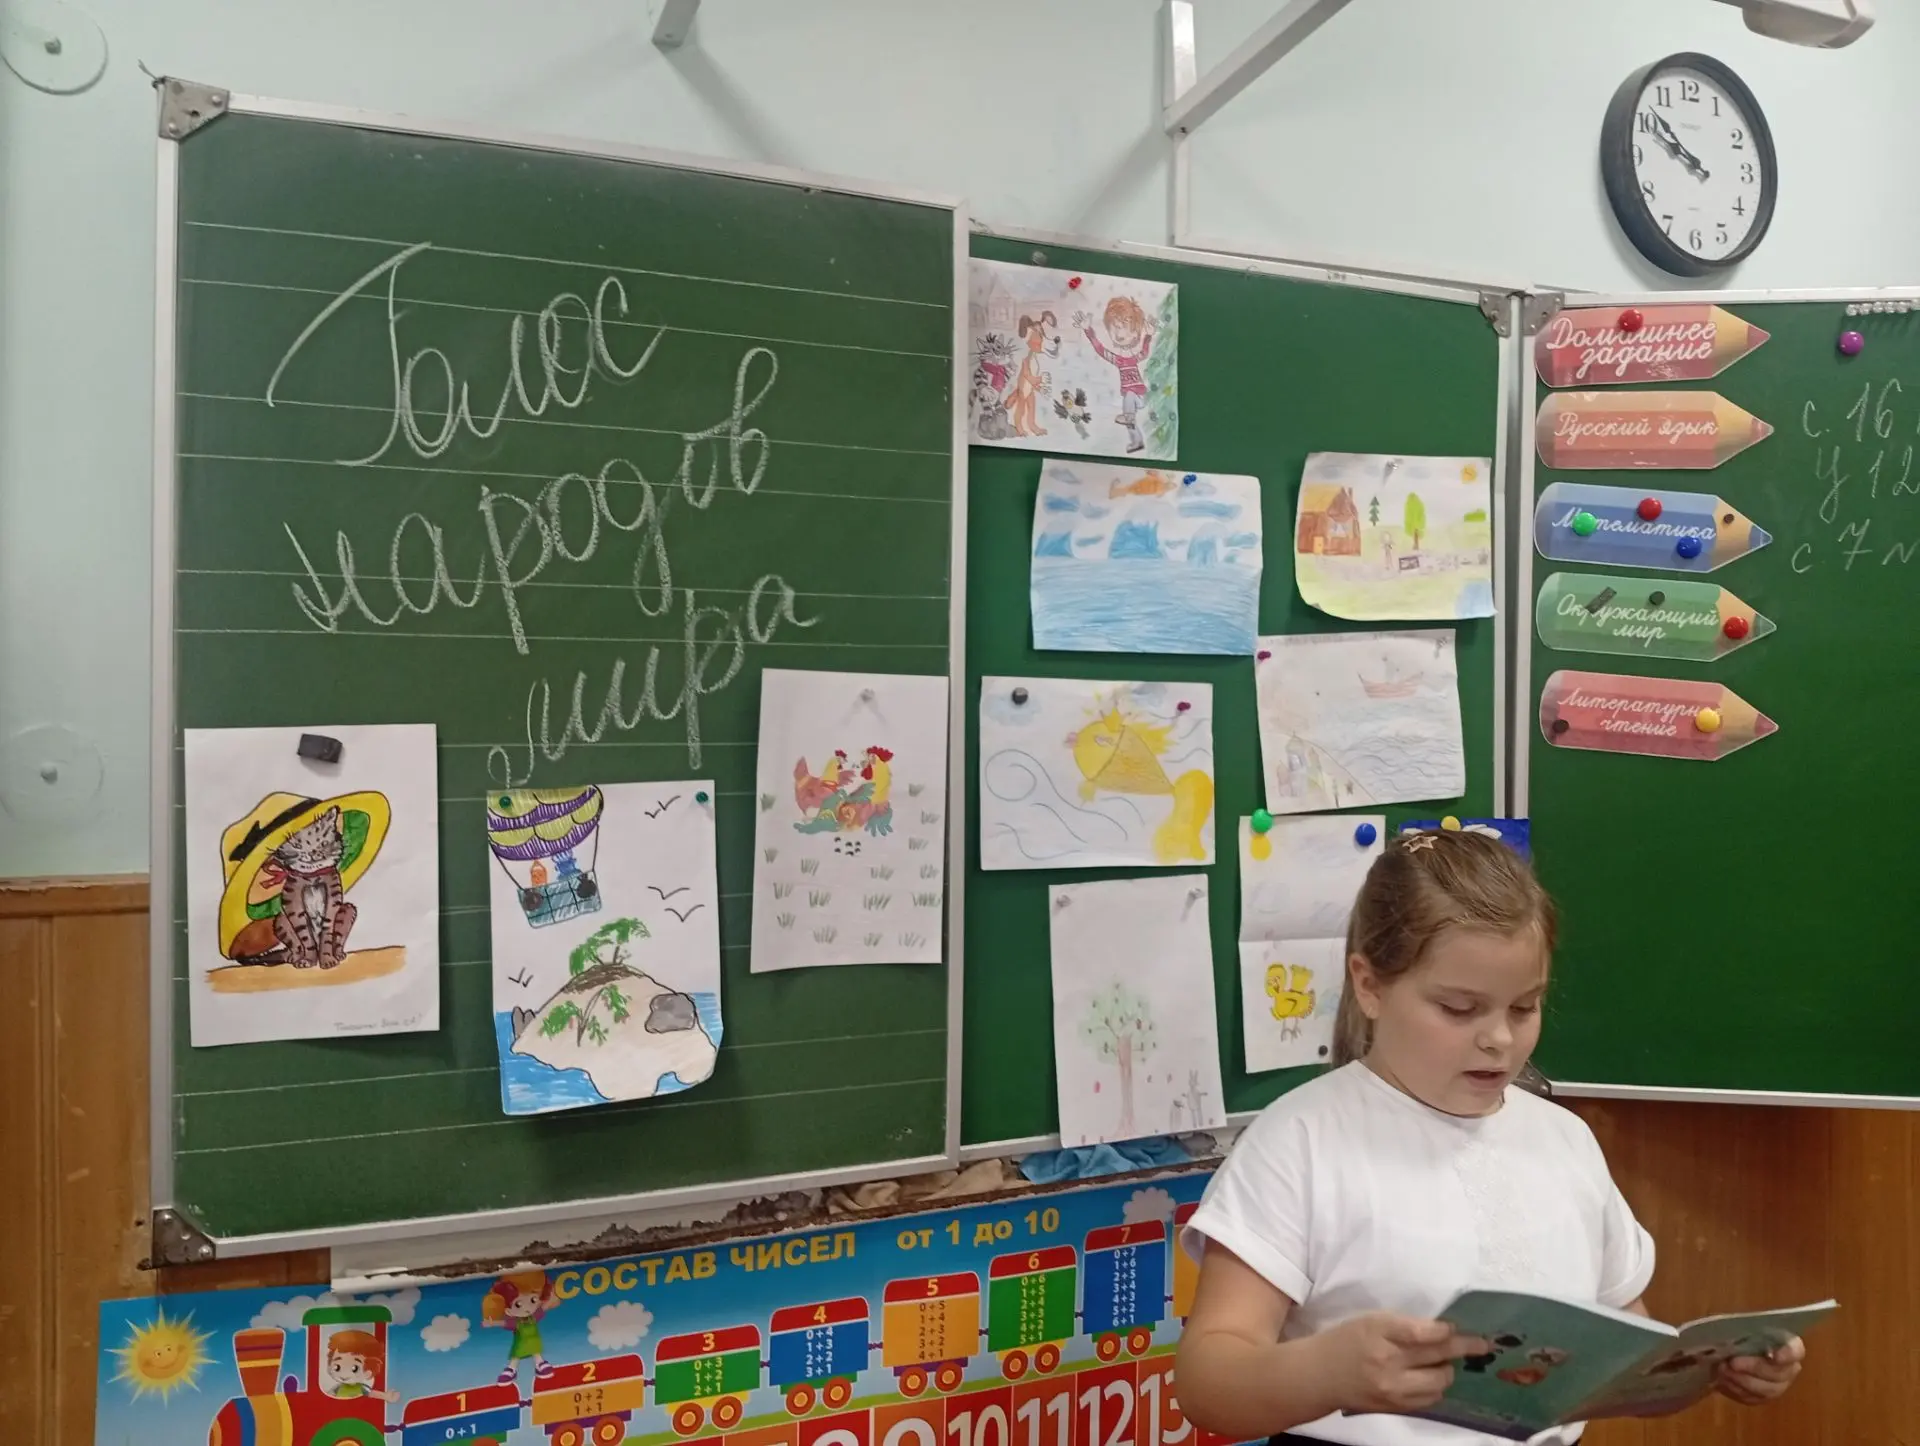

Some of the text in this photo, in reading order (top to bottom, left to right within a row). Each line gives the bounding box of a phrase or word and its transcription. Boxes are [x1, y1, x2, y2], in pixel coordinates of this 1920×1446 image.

[1656, 86, 1673, 108] 11
[1680, 80, 1699, 102] 12
[1712, 97, 1721, 117] 1
[1637, 112, 1658, 134] 10
[1731, 128, 1743, 150] 2
[1740, 162, 1754, 184] 3
[1641, 180, 1655, 203] 8
[1731, 195, 1745, 216] 4
[1662, 214, 1674, 236] 7
[1715, 222, 1728, 244] 5
[1689, 229, 1702, 251] 6
[1575, 341, 1713, 379] задание
[1846, 378, 1902, 442] 16
[1554, 412, 1718, 446] Русский язык
[1551, 507, 1717, 541] Мтематика
[1838, 518, 1873, 571] 7
[1612, 625, 1667, 648] мир
[1600, 718, 1677, 737] чтение
[1120, 1227, 1131, 1243] 7
[555, 1207, 1060, 1300] СОСТАВ ЧИСЕЛ от 1 до 10
[1028, 1252, 1040, 1270] 6
[927, 1278, 939, 1296] 5
[813, 1305, 827, 1323] 4
[702, 1332, 716, 1351] 3
[582, 1362, 596, 1382] 2
[456, 1392, 466, 1412] 1
[1079, 1379, 1135, 1446] 12
